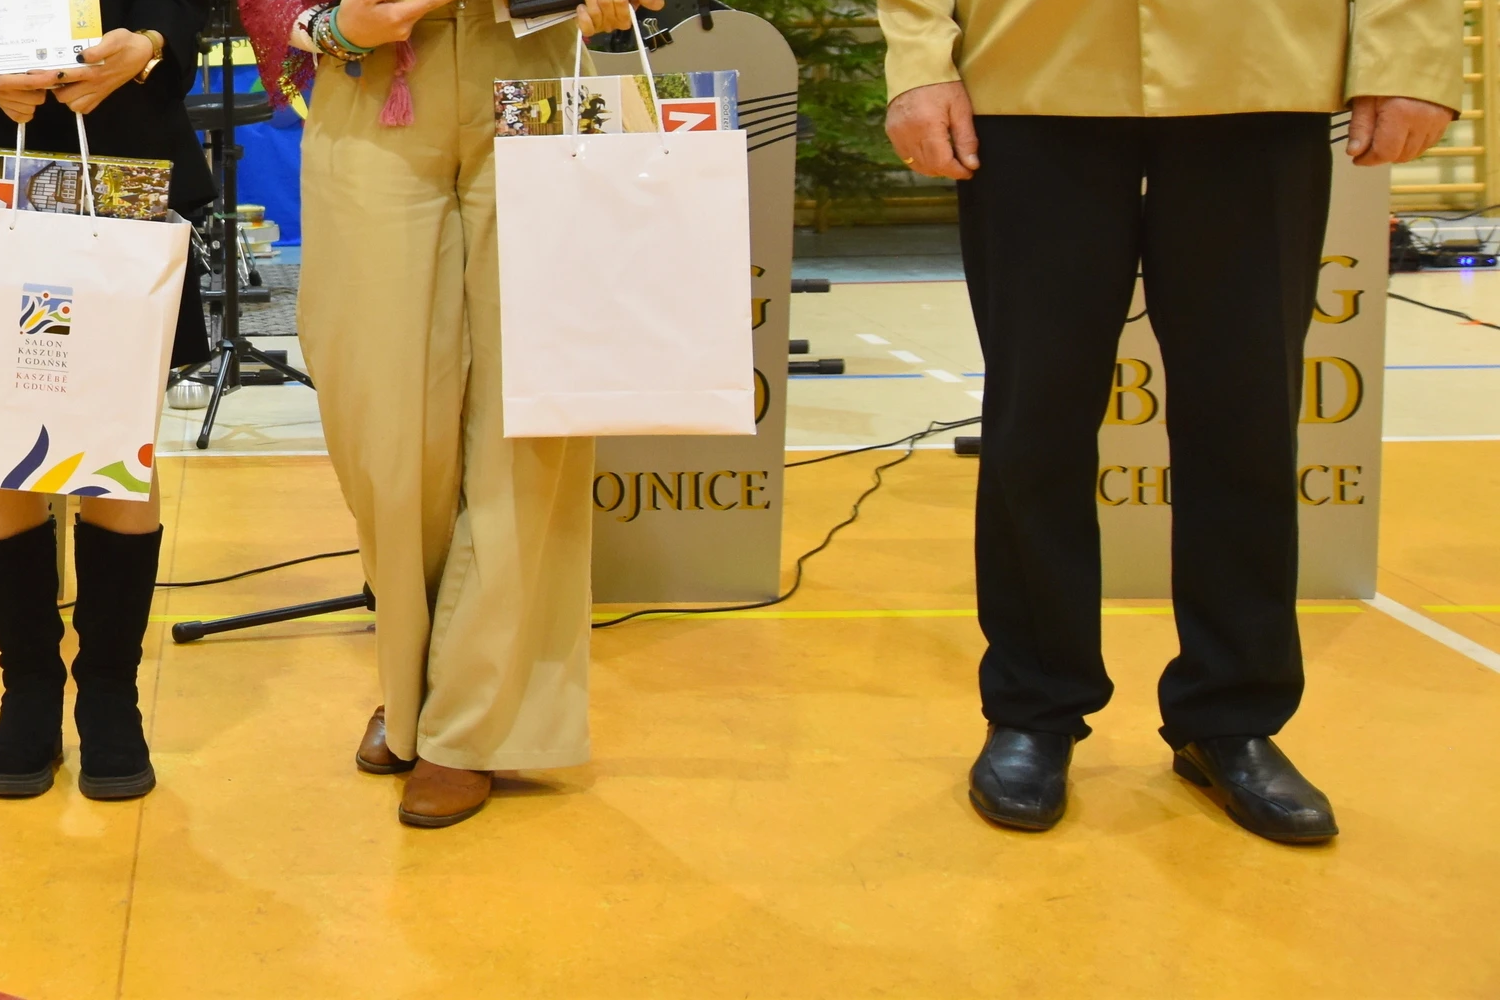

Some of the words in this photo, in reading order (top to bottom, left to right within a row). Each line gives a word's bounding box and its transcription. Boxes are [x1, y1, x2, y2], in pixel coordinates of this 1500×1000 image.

[25, 339, 63, 348] SALON
[18, 347, 69, 358] KASZUBY
[25, 357, 68, 368] GDAŃSK
[593, 470, 771, 523] OJNICE
